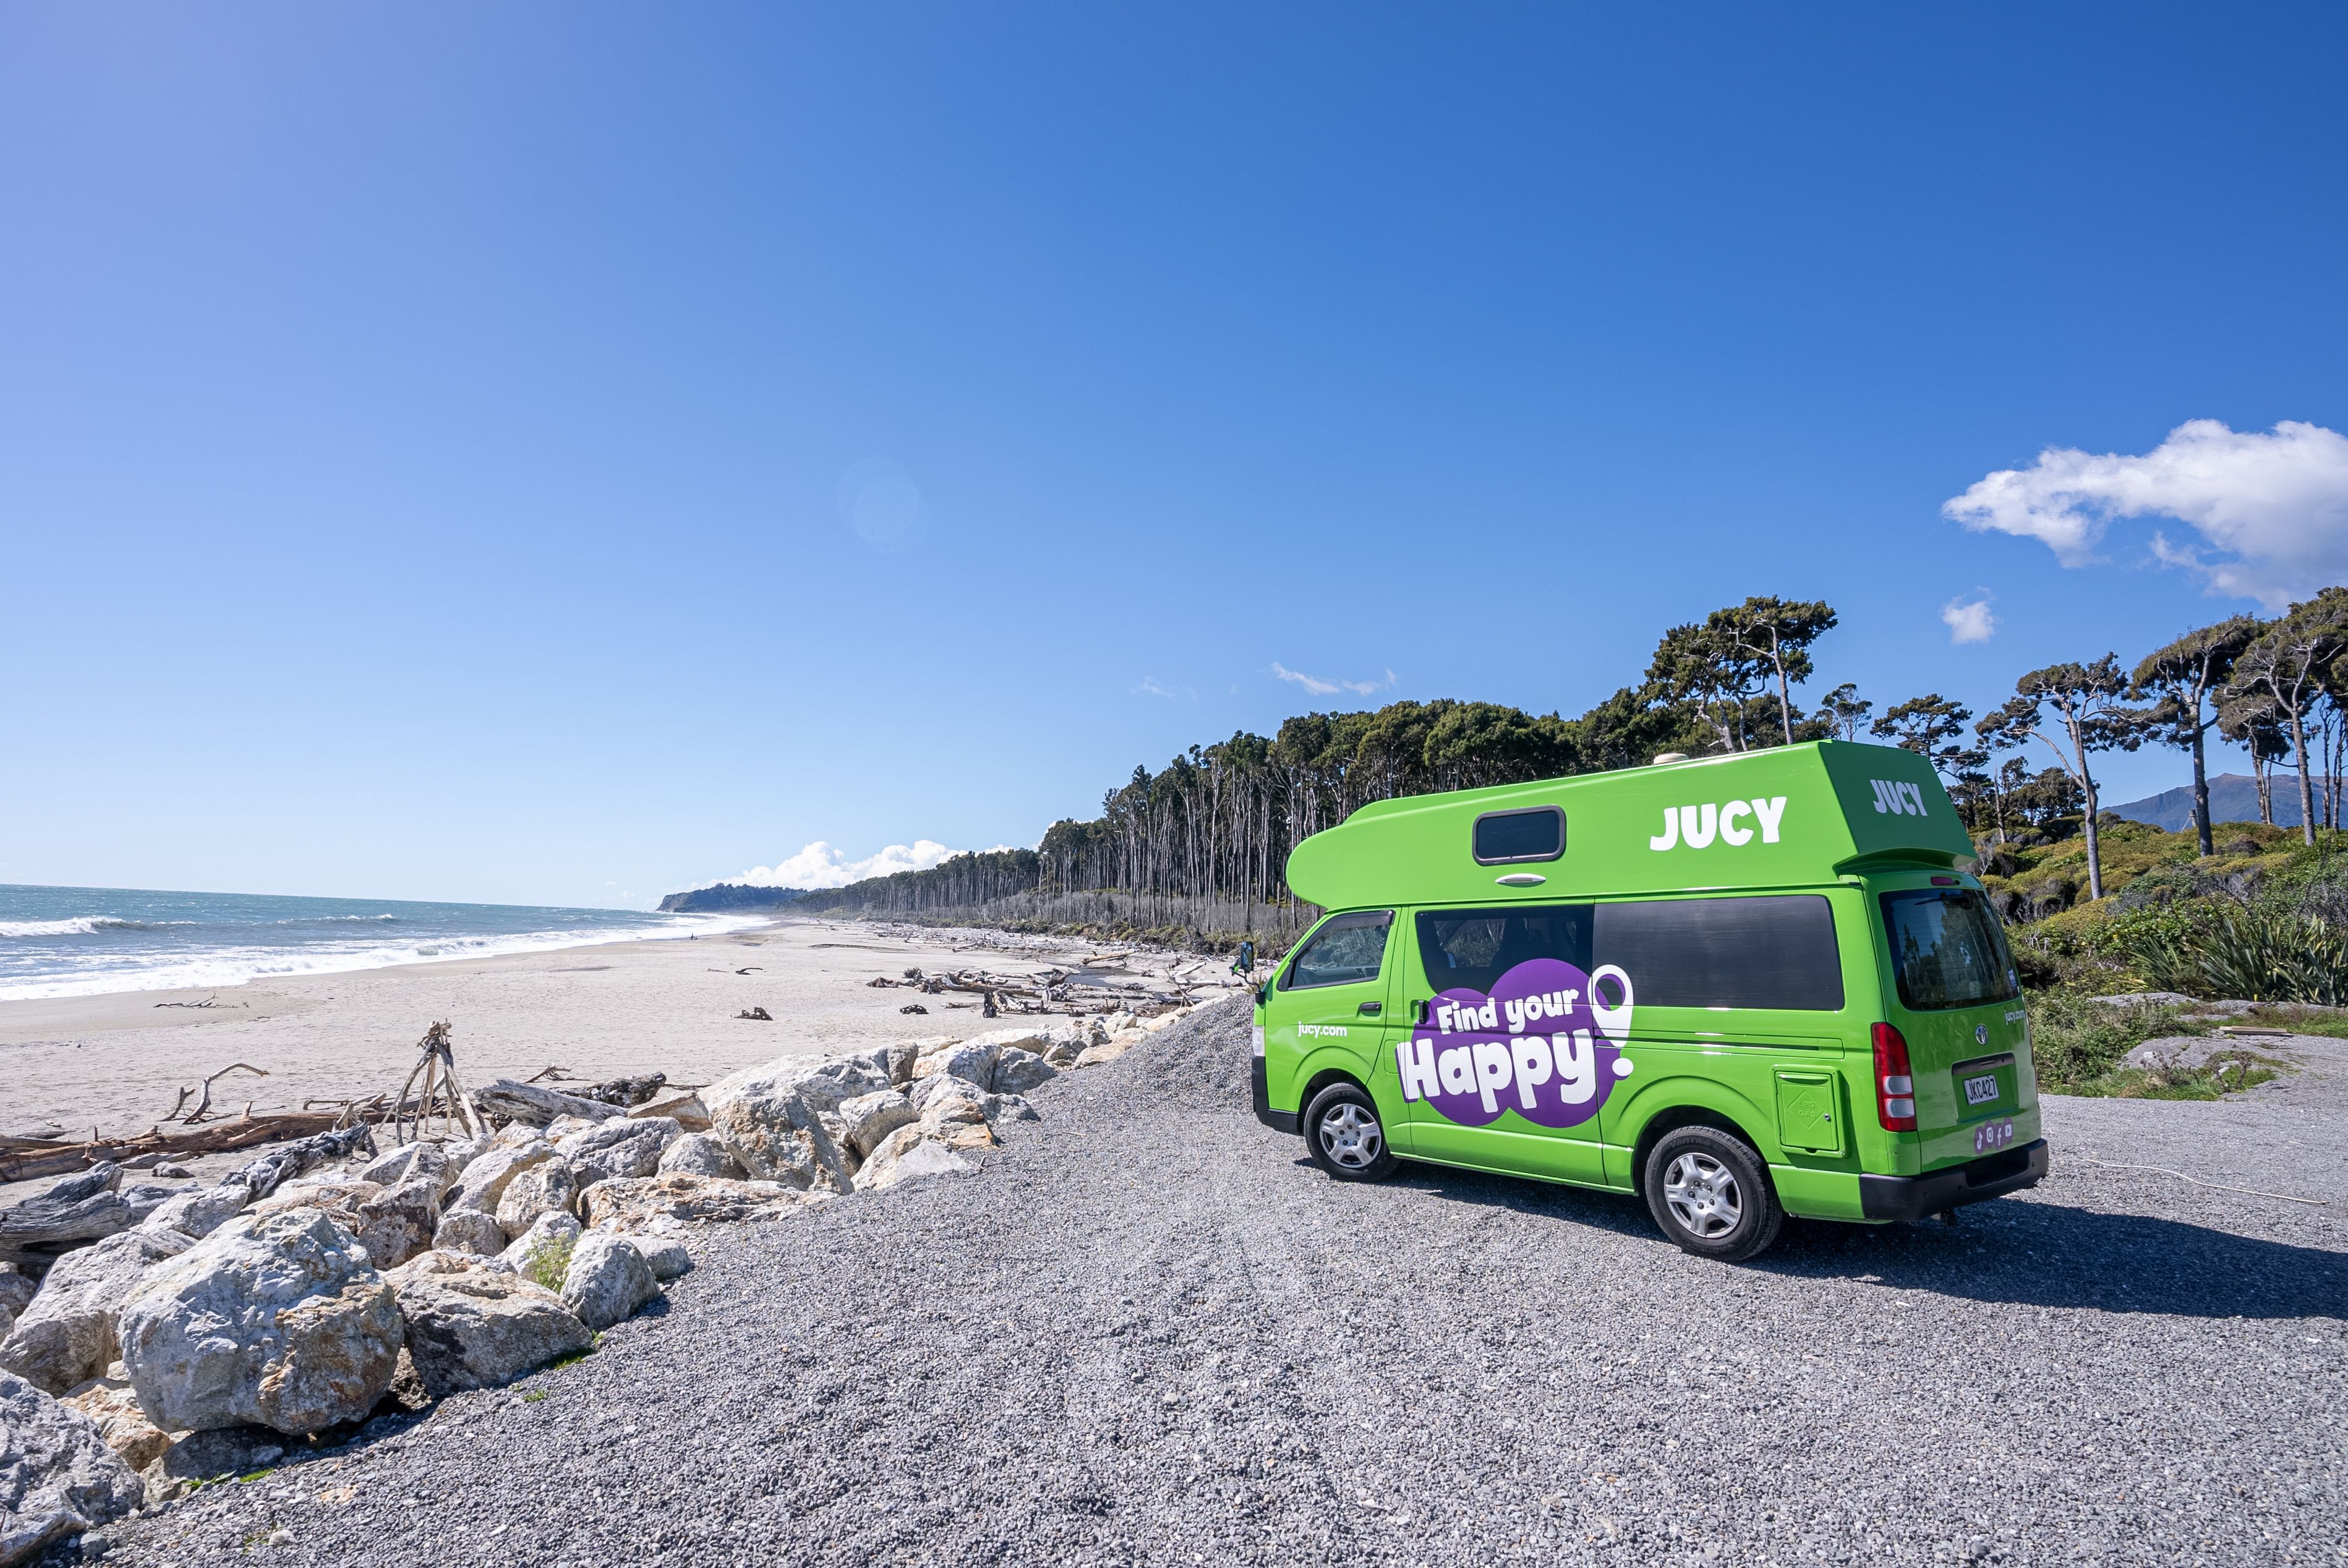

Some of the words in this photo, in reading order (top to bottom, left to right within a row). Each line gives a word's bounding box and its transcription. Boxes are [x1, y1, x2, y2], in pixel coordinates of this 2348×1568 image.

[1870, 779, 1927, 816] JUCY
[1649, 796, 1787, 851] JUCY
[1437, 997, 1498, 1035] Find
[1505, 989, 1579, 1034] your
[1297, 1021, 1347, 1039] jucy.com
[1968, 1078, 1996, 1101] JKC427
[1798, 1101, 1816, 1109] LPG
[1798, 1110, 1816, 1118] GAS
